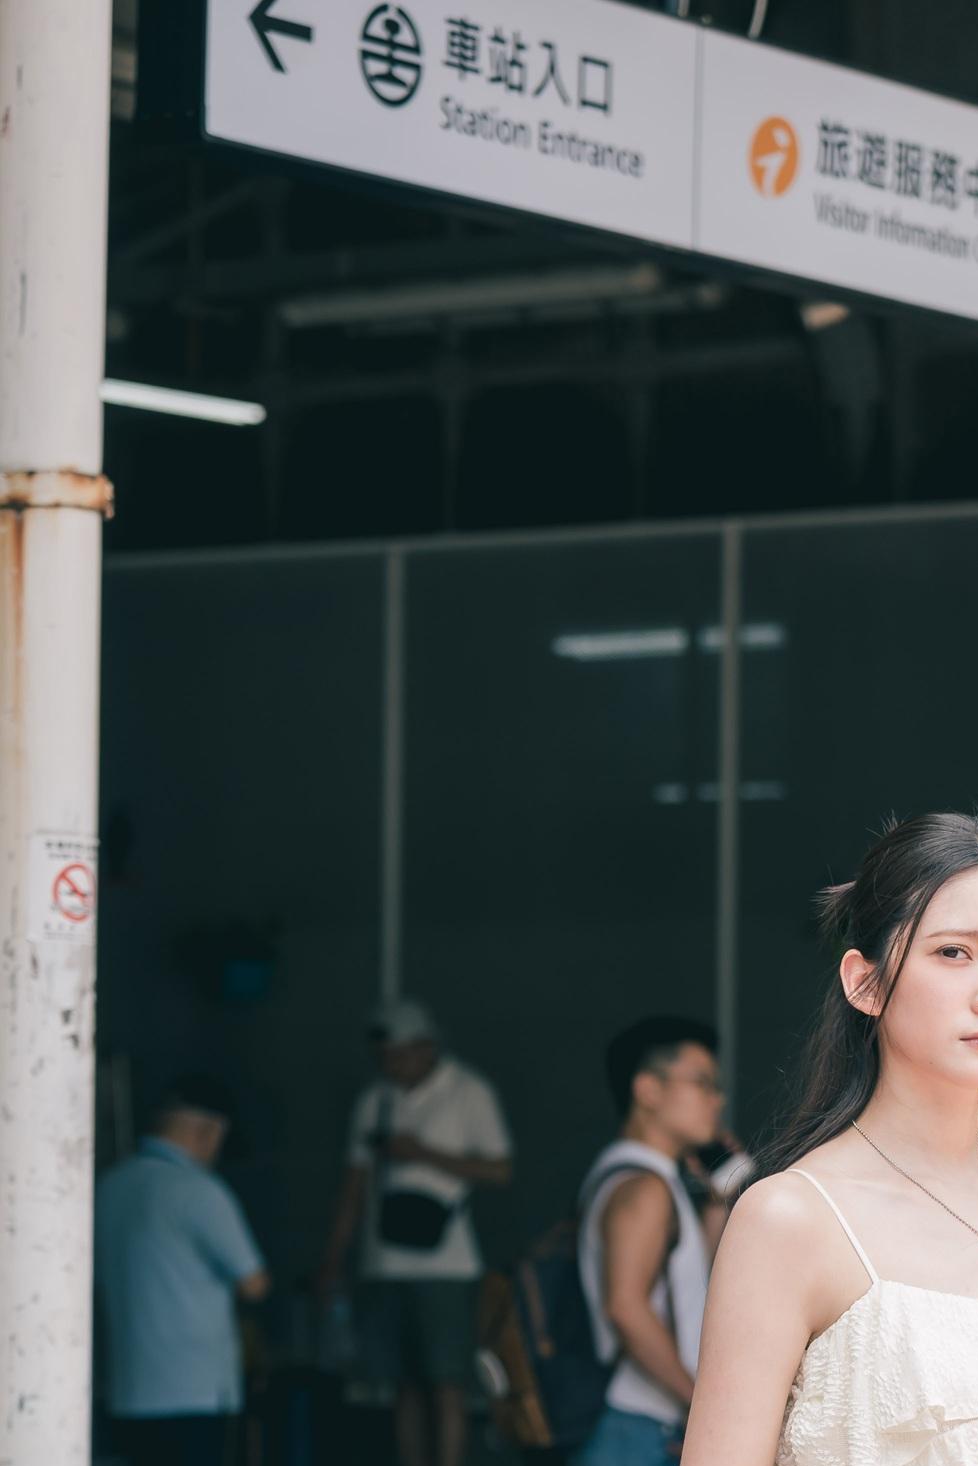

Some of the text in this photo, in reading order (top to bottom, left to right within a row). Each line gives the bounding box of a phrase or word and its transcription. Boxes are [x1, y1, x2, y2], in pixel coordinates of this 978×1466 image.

[442, 16, 614, 114] 車站入口
[440, 97, 644, 177] Station Entrance
[814, 193, 870, 232] Visitor
[874, 209, 969, 259] Information
